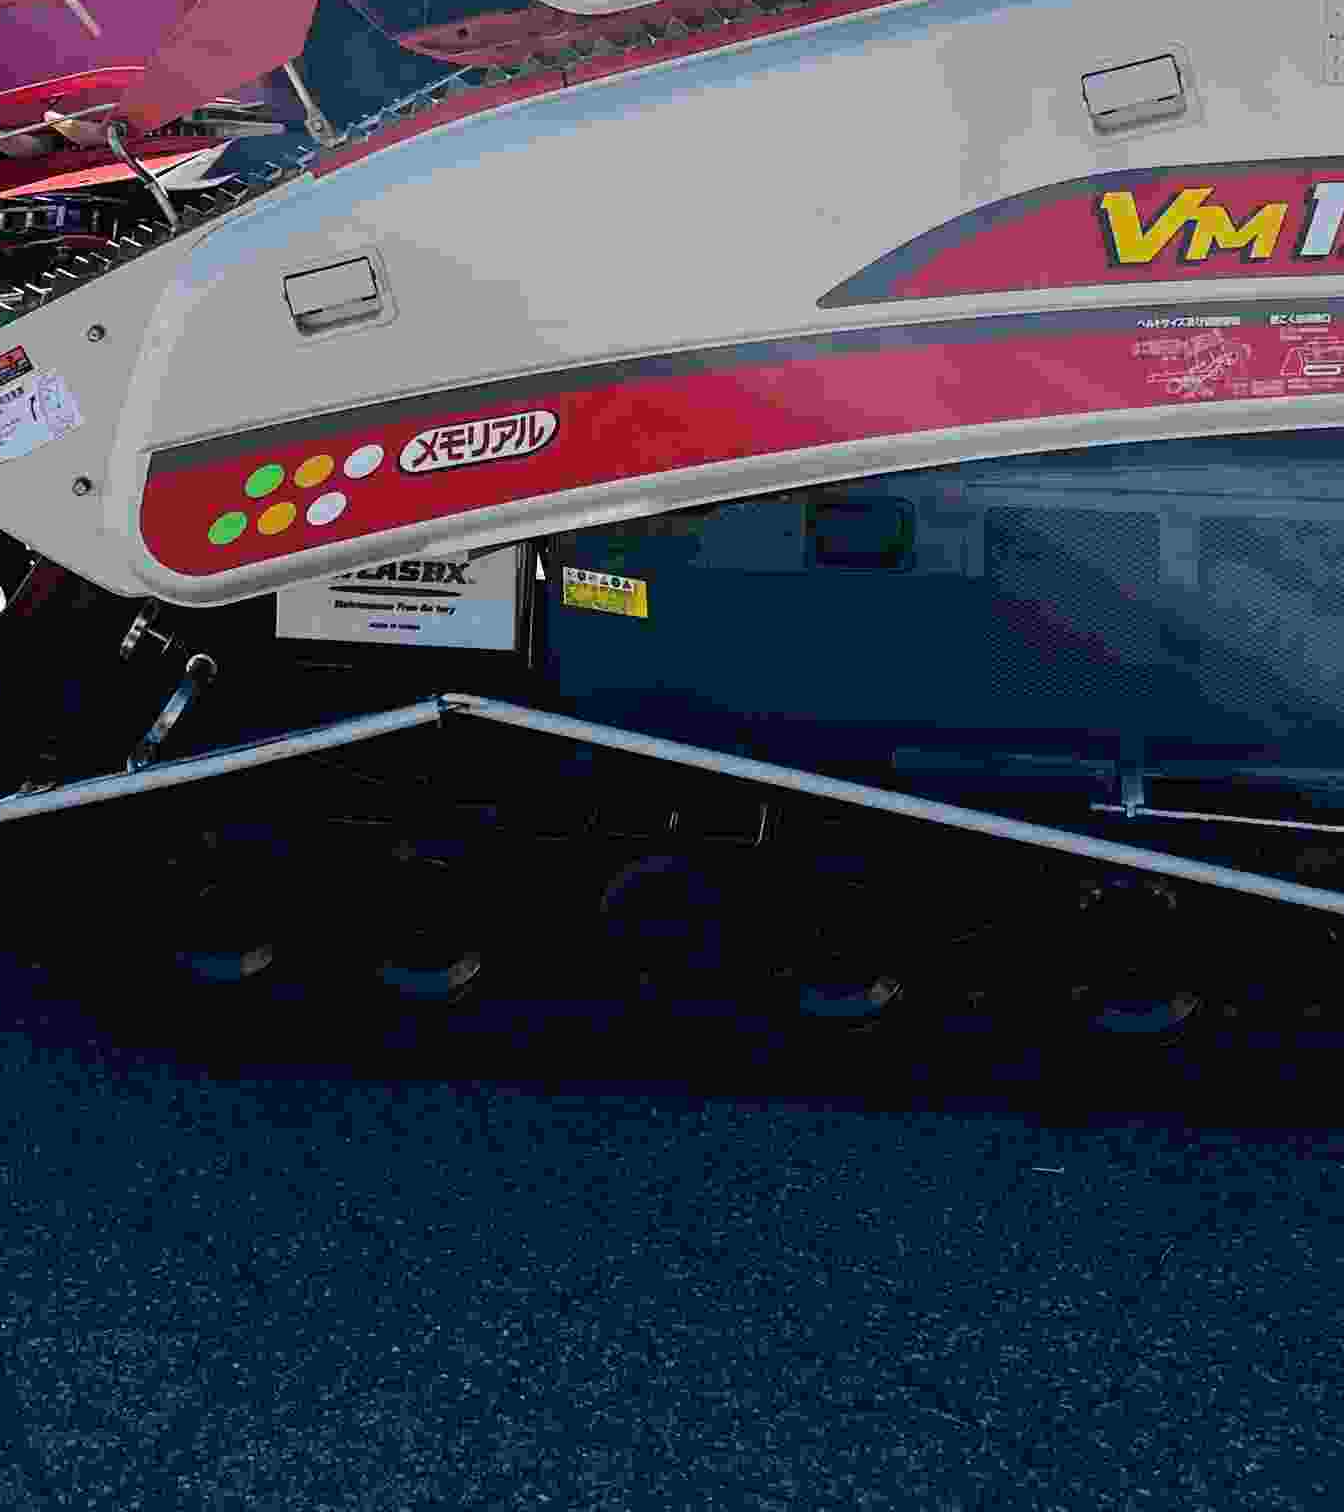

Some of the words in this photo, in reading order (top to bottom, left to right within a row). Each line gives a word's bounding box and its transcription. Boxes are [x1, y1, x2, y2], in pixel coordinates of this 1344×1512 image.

[412, 414, 546, 468] メモリアル
